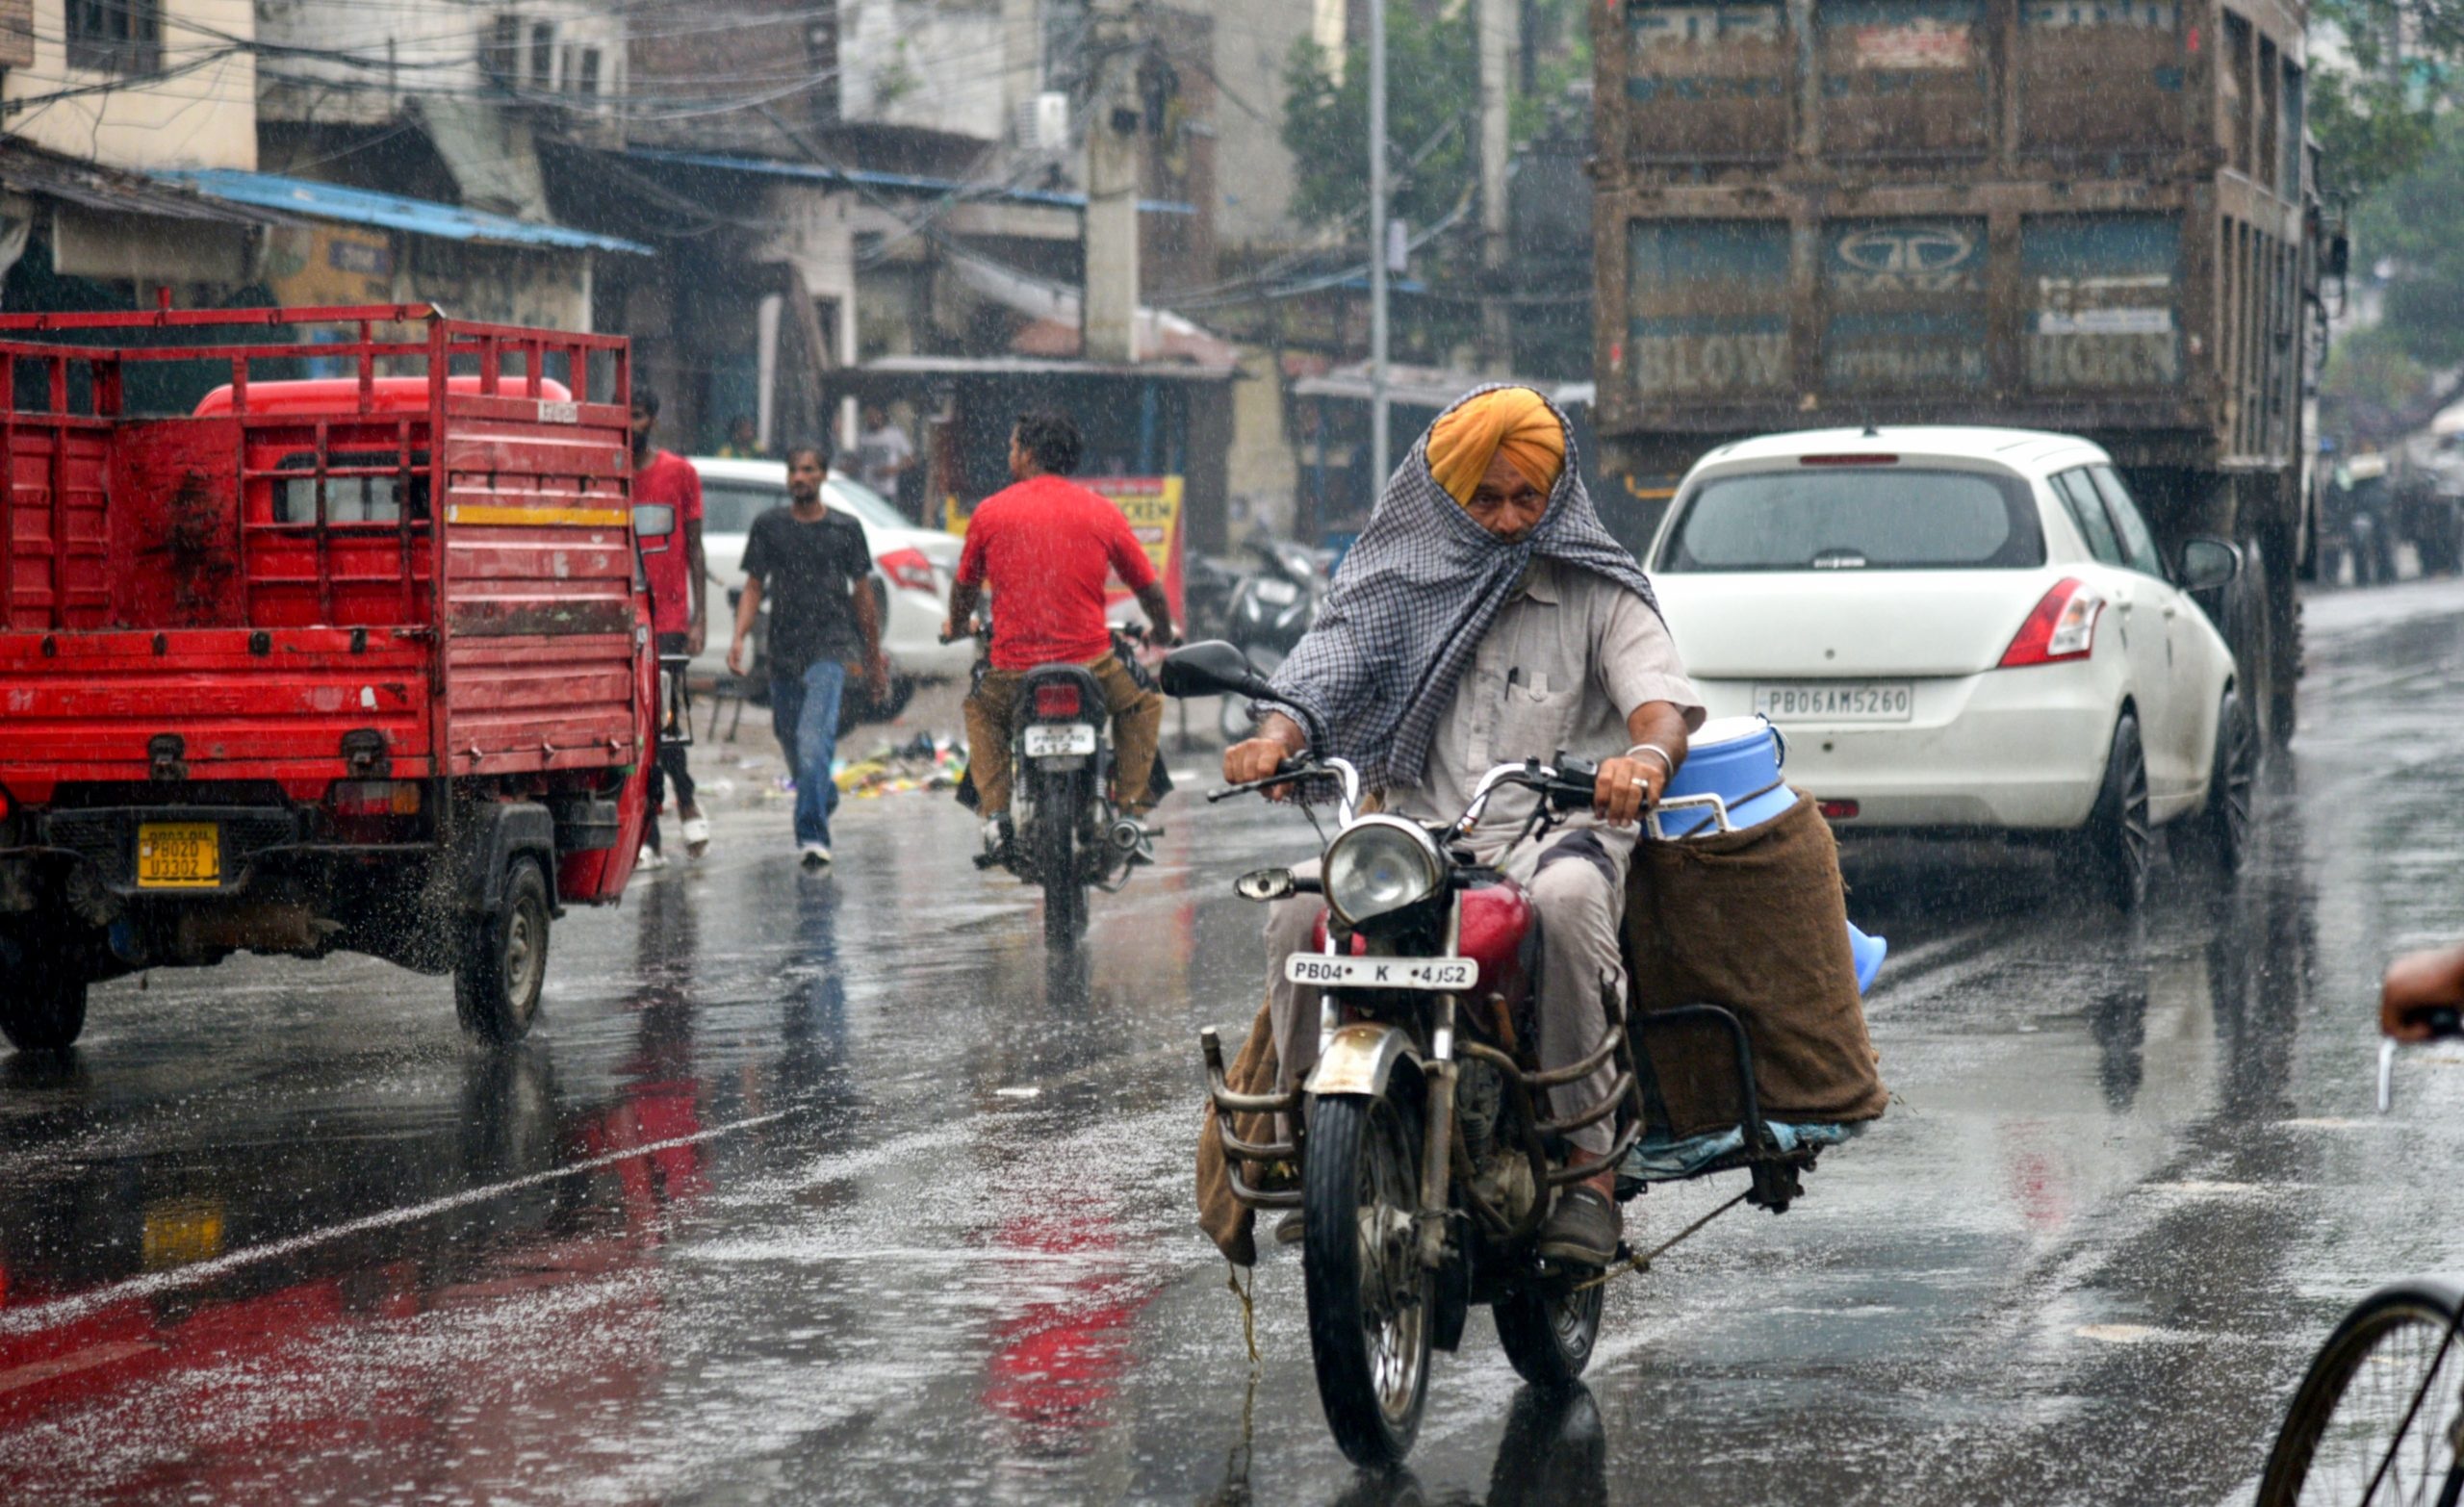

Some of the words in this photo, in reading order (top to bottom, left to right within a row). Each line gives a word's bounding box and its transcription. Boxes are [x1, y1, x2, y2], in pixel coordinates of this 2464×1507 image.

[1637, 335, 1790, 388] BLOW
[2028, 334, 2177, 383] HORN
[1769, 690, 1907, 713] PB06AM5260
[1295, 962, 1343, 981] PB04
[1375, 965, 1390, 981] K
